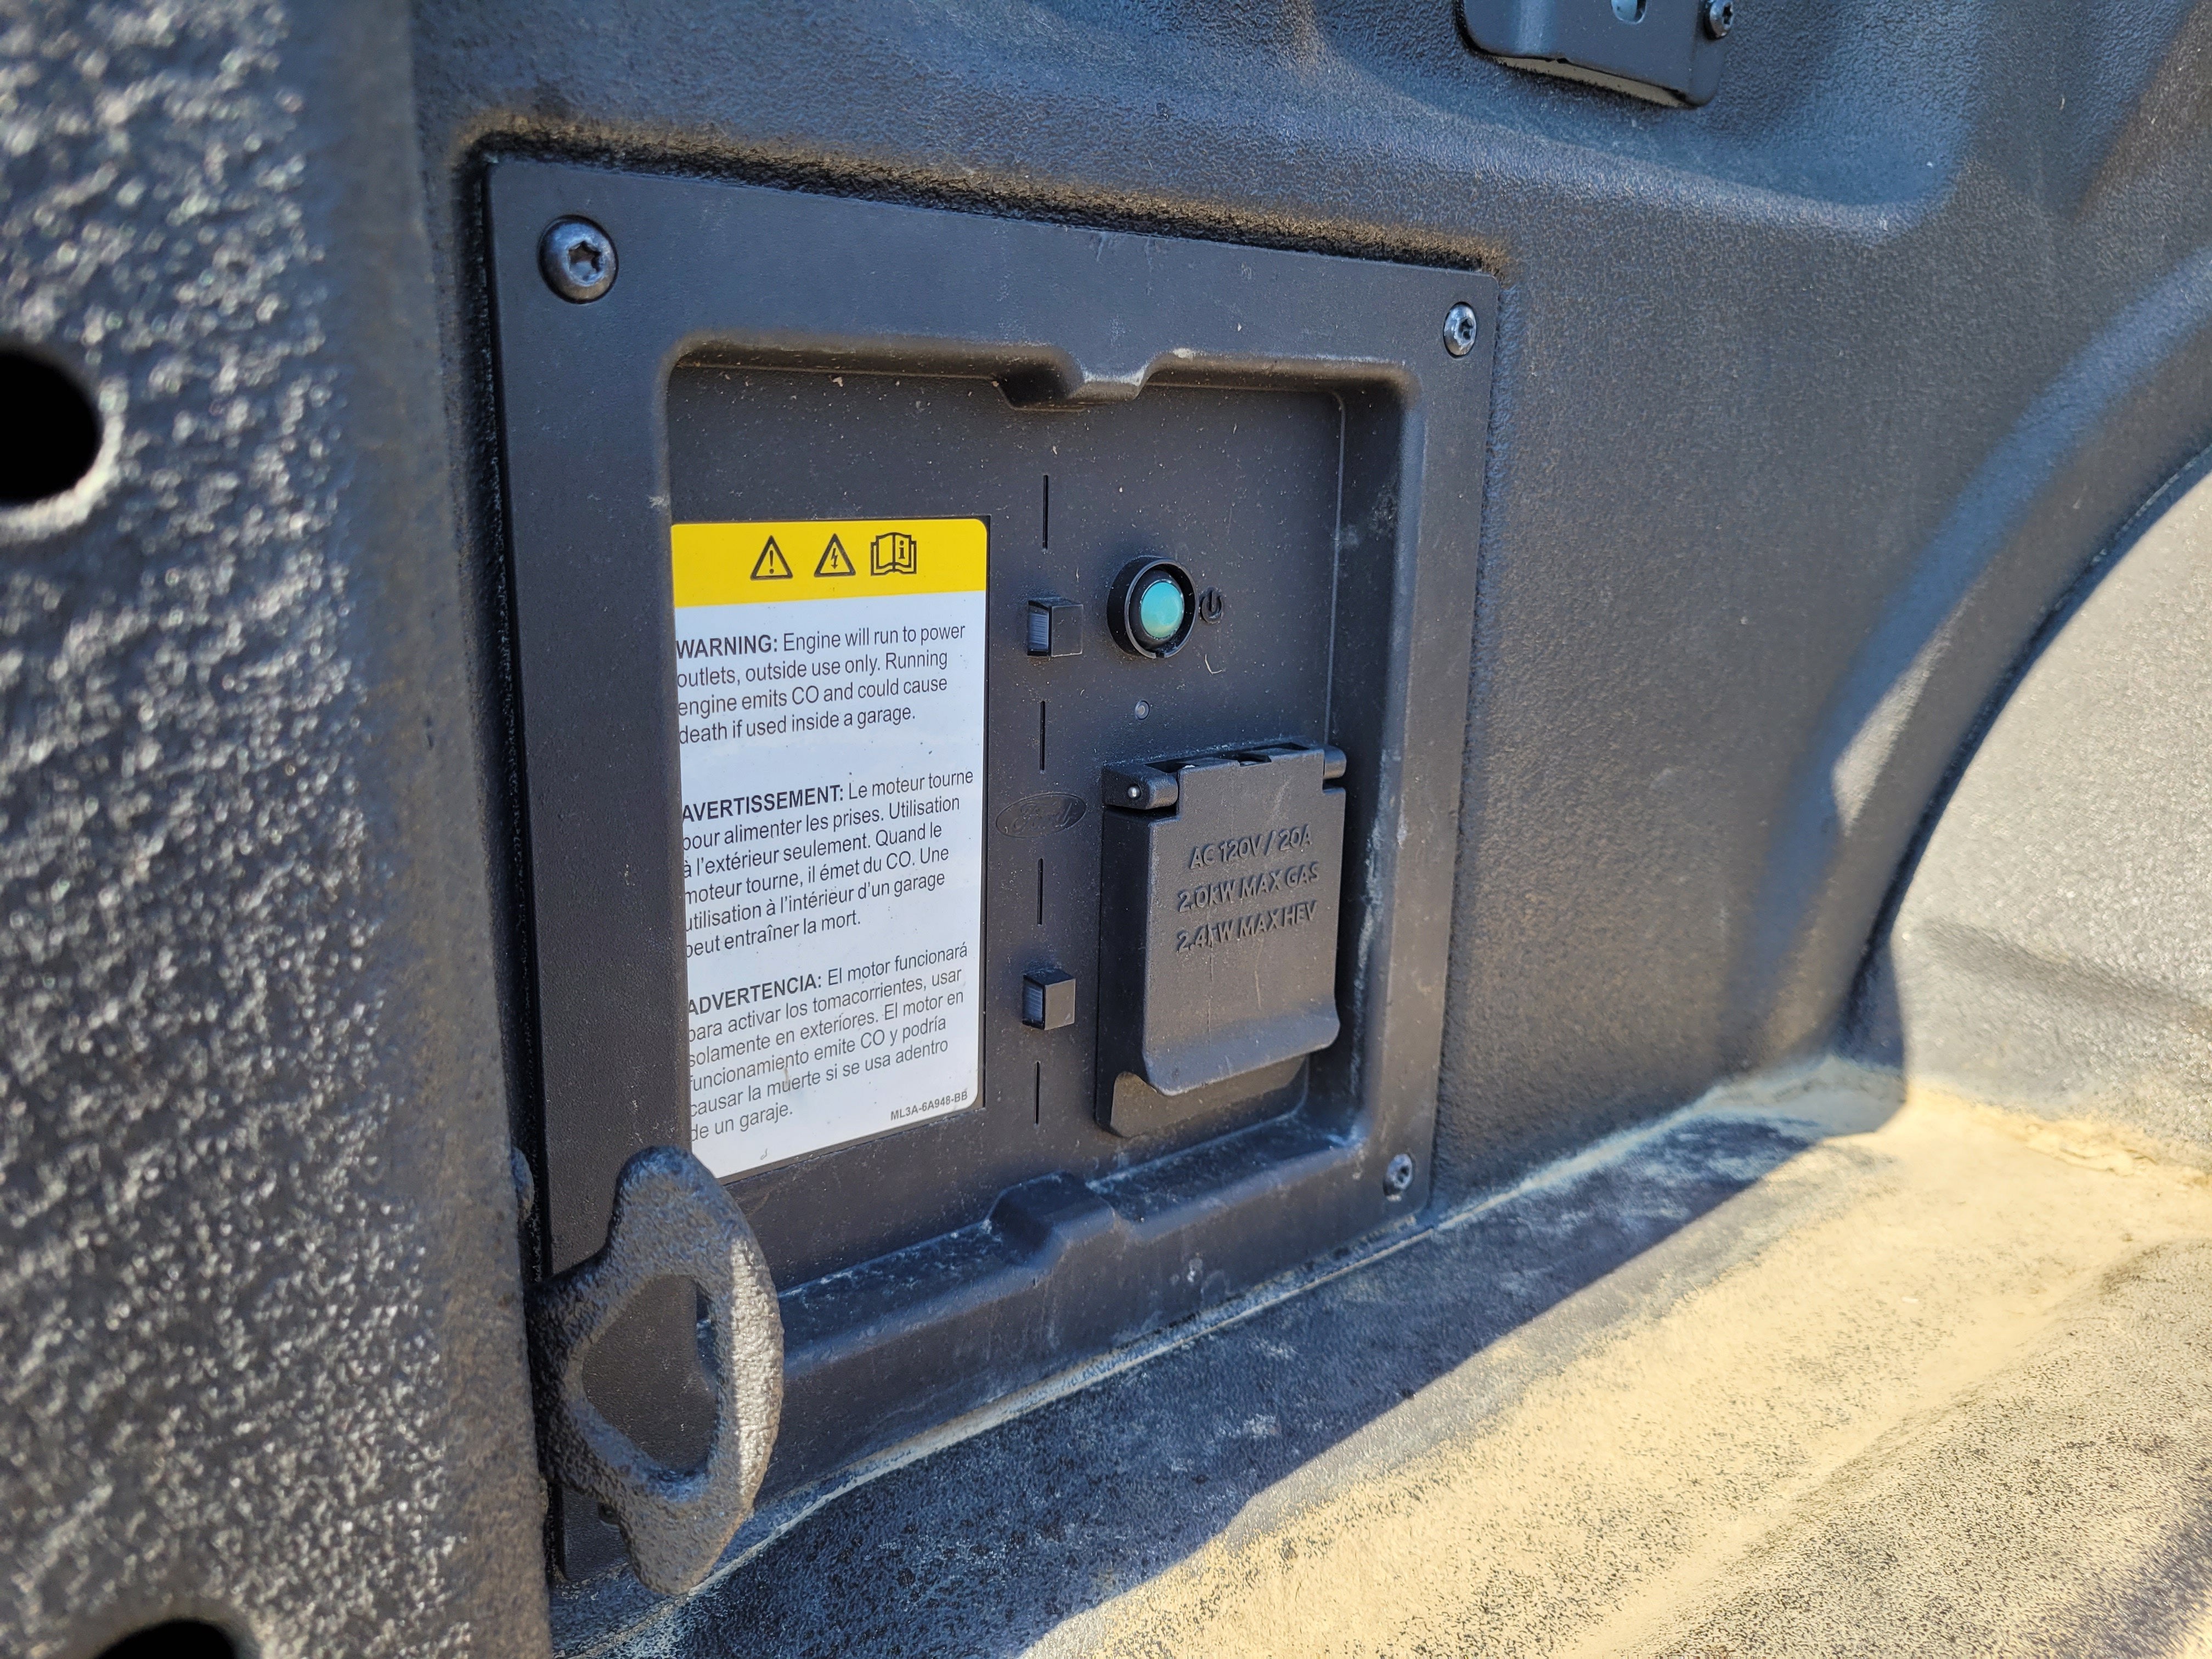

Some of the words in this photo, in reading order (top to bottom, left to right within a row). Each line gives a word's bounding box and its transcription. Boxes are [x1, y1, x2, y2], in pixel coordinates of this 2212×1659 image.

[676, 634, 777, 659] WARNING:
[783, 630, 841, 654] Engine
[845, 627, 869, 647] will
[874, 630, 898, 645] run
[902, 625, 917, 642] to
[921, 625, 966, 646] power
[678, 666, 740, 688] outlets,
[746, 659, 807, 682] outside
[812, 661, 840, 676] use
[845, 654, 880, 676] only.
[886, 649, 947, 670] Running
[679, 694, 737, 719] engine
[742, 689, 787, 710] emits
[792, 685, 819, 705] CO
[823, 681, 853, 702] and
[857, 678, 899, 698] could
[903, 678, 947, 695] cause
[680, 721, 727, 744] death
[732, 719, 743, 738] if
[746, 715, 786, 737] used
[792, 710, 839, 732] inside
[843, 713, 853, 726] a
[857, 707, 915, 730] garage.
[682, 785, 843, 822] AVERTISSEMENT:
[849, 782, 867, 800] Le
[872, 777, 925, 797] moteur
[928, 771, 973, 789] tourne
[1010, 799, 1074, 834] Fod
[724, 819, 802, 844] alimenter
[806, 814, 828, 832] les
[833, 808, 884, 833] prises.
[889, 795, 960, 820] Utilisation
[684, 859, 692, 879] à
[783, 833, 871, 861] seulement.
[876, 822, 926, 847] Quand
[930, 821, 942, 838] le
[1190, 844, 1215, 870] AC
[1220, 834, 1262, 862] 120V
[1279, 824, 1312, 851] 20A
[746, 873, 803, 894] tourne,
[808, 865, 815, 883] il
[820, 859, 860, 881] émet
[863, 856, 882, 874] du
[886, 850, 915, 870] CO.
[920, 847, 949, 864] Une
[1240, 870, 1282, 899] MAX
[1286, 861, 1319, 888] GAS
[766, 899, 776, 916] à
[894, 873, 945, 898] garage
[724, 923, 800, 950] entraîner
[803, 918, 816, 935] la
[821, 910, 860, 931] mort.
[1238, 908, 1280, 939] MAX
[1282, 900, 1317, 927] HEV
[689, 973, 821, 1015] ADVERTENCIA:
[828, 967, 842, 986] El
[848, 961, 891, 984] motor
[894, 941, 967, 972] funcionará
[728, 1008, 781, 1032] activar
[786, 1002, 808, 1019] los
[812, 978, 926, 1013] tomacorrientes,
[932, 969, 962, 986] usar
[690, 1034, 770, 1068] solamente
[776, 1030, 794, 1046] en
[800, 1012, 878, 1040] exteriores.
[884, 1002, 898, 1020] El
[903, 996, 944, 1017] motor
[947, 991, 963, 1006] en
[690, 1049, 809, 1091] uncionamiento
[814, 1039, 855, 1060] emite
[860, 1029, 885, 1049] CO
[890, 1029, 898, 1047] y
[902, 1015, 946, 1043] podría
[691, 1091, 743, 1117] causar
[748, 1085, 761, 1102] la
[768, 1070, 821, 1097] muerte
[826, 1063, 837, 1081] si
[843, 1062, 860, 1077] se
[865, 1054, 890, 1071] usa
[895, 1040, 948, 1064] adentro
[692, 1124, 709, 1142] de
[715, 1119, 734, 1135] un
[740, 1102, 793, 1132] garaje.
[891, 1091, 968, 1120] ML3A-6A948-BB
